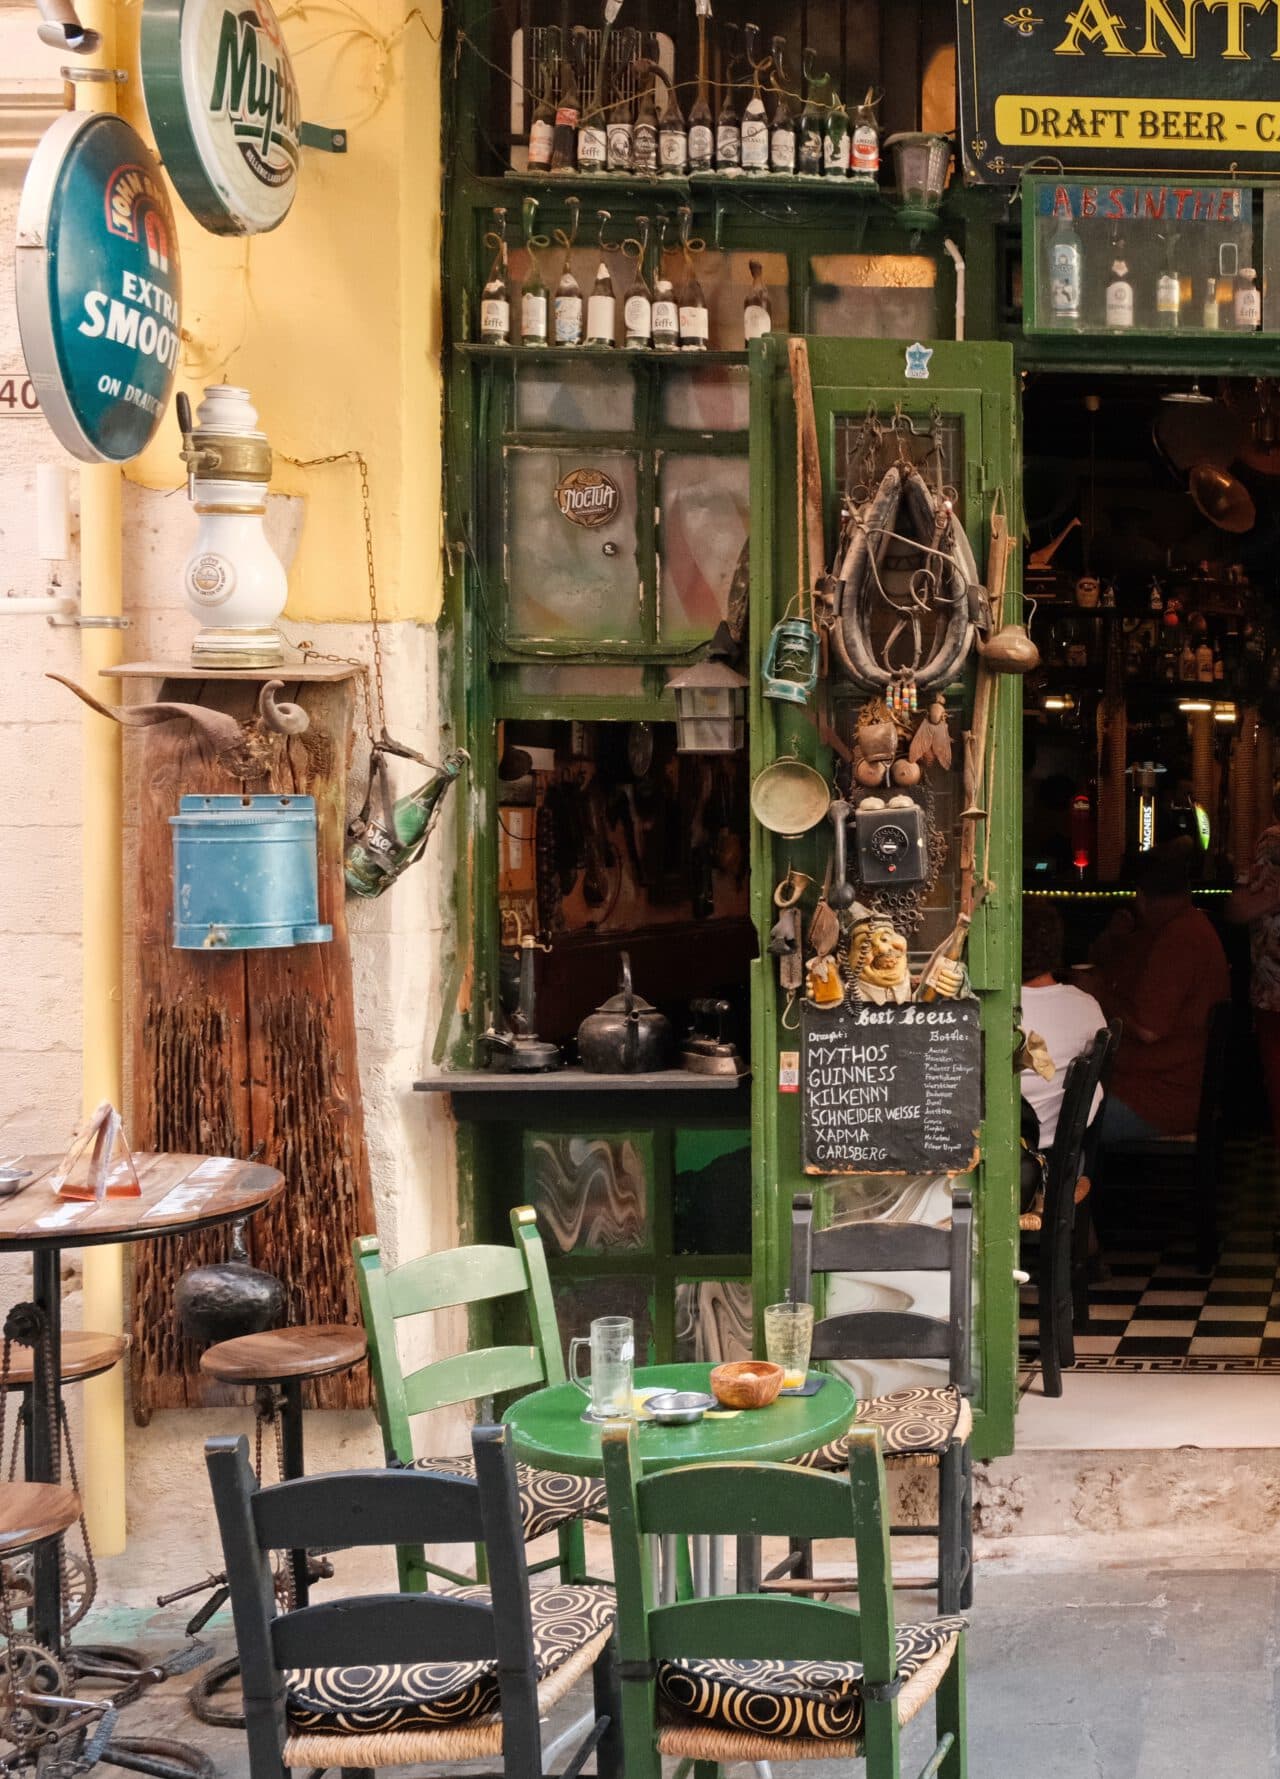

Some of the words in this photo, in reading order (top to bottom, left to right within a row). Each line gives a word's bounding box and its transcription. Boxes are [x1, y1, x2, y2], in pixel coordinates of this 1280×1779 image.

[1020, 107, 1128, 139] DRAFT
[1139, 111, 1225, 142] BEER
[111, 171, 145, 233] JOHN
[1052, 184, 1236, 222] ABSINTHE
[122, 270, 179, 328] EXTRA
[98, 374, 121, 397] ON
[561, 483, 616, 513] NOCTUA
[1143, 806, 1152, 852] MAGNERS
[854, 1007, 895, 1026] Best
[899, 1006, 957, 1025] Beers
[808, 1044, 890, 1068] MYTHOS
[808, 1065, 898, 1088] GUINNESS
[809, 1086, 889, 1107] KILKENNY
[811, 1107, 884, 1127] SCHNEIDER
[884, 1105, 921, 1121] WEISSE
[816, 1143, 888, 1162] CARLSBERG
